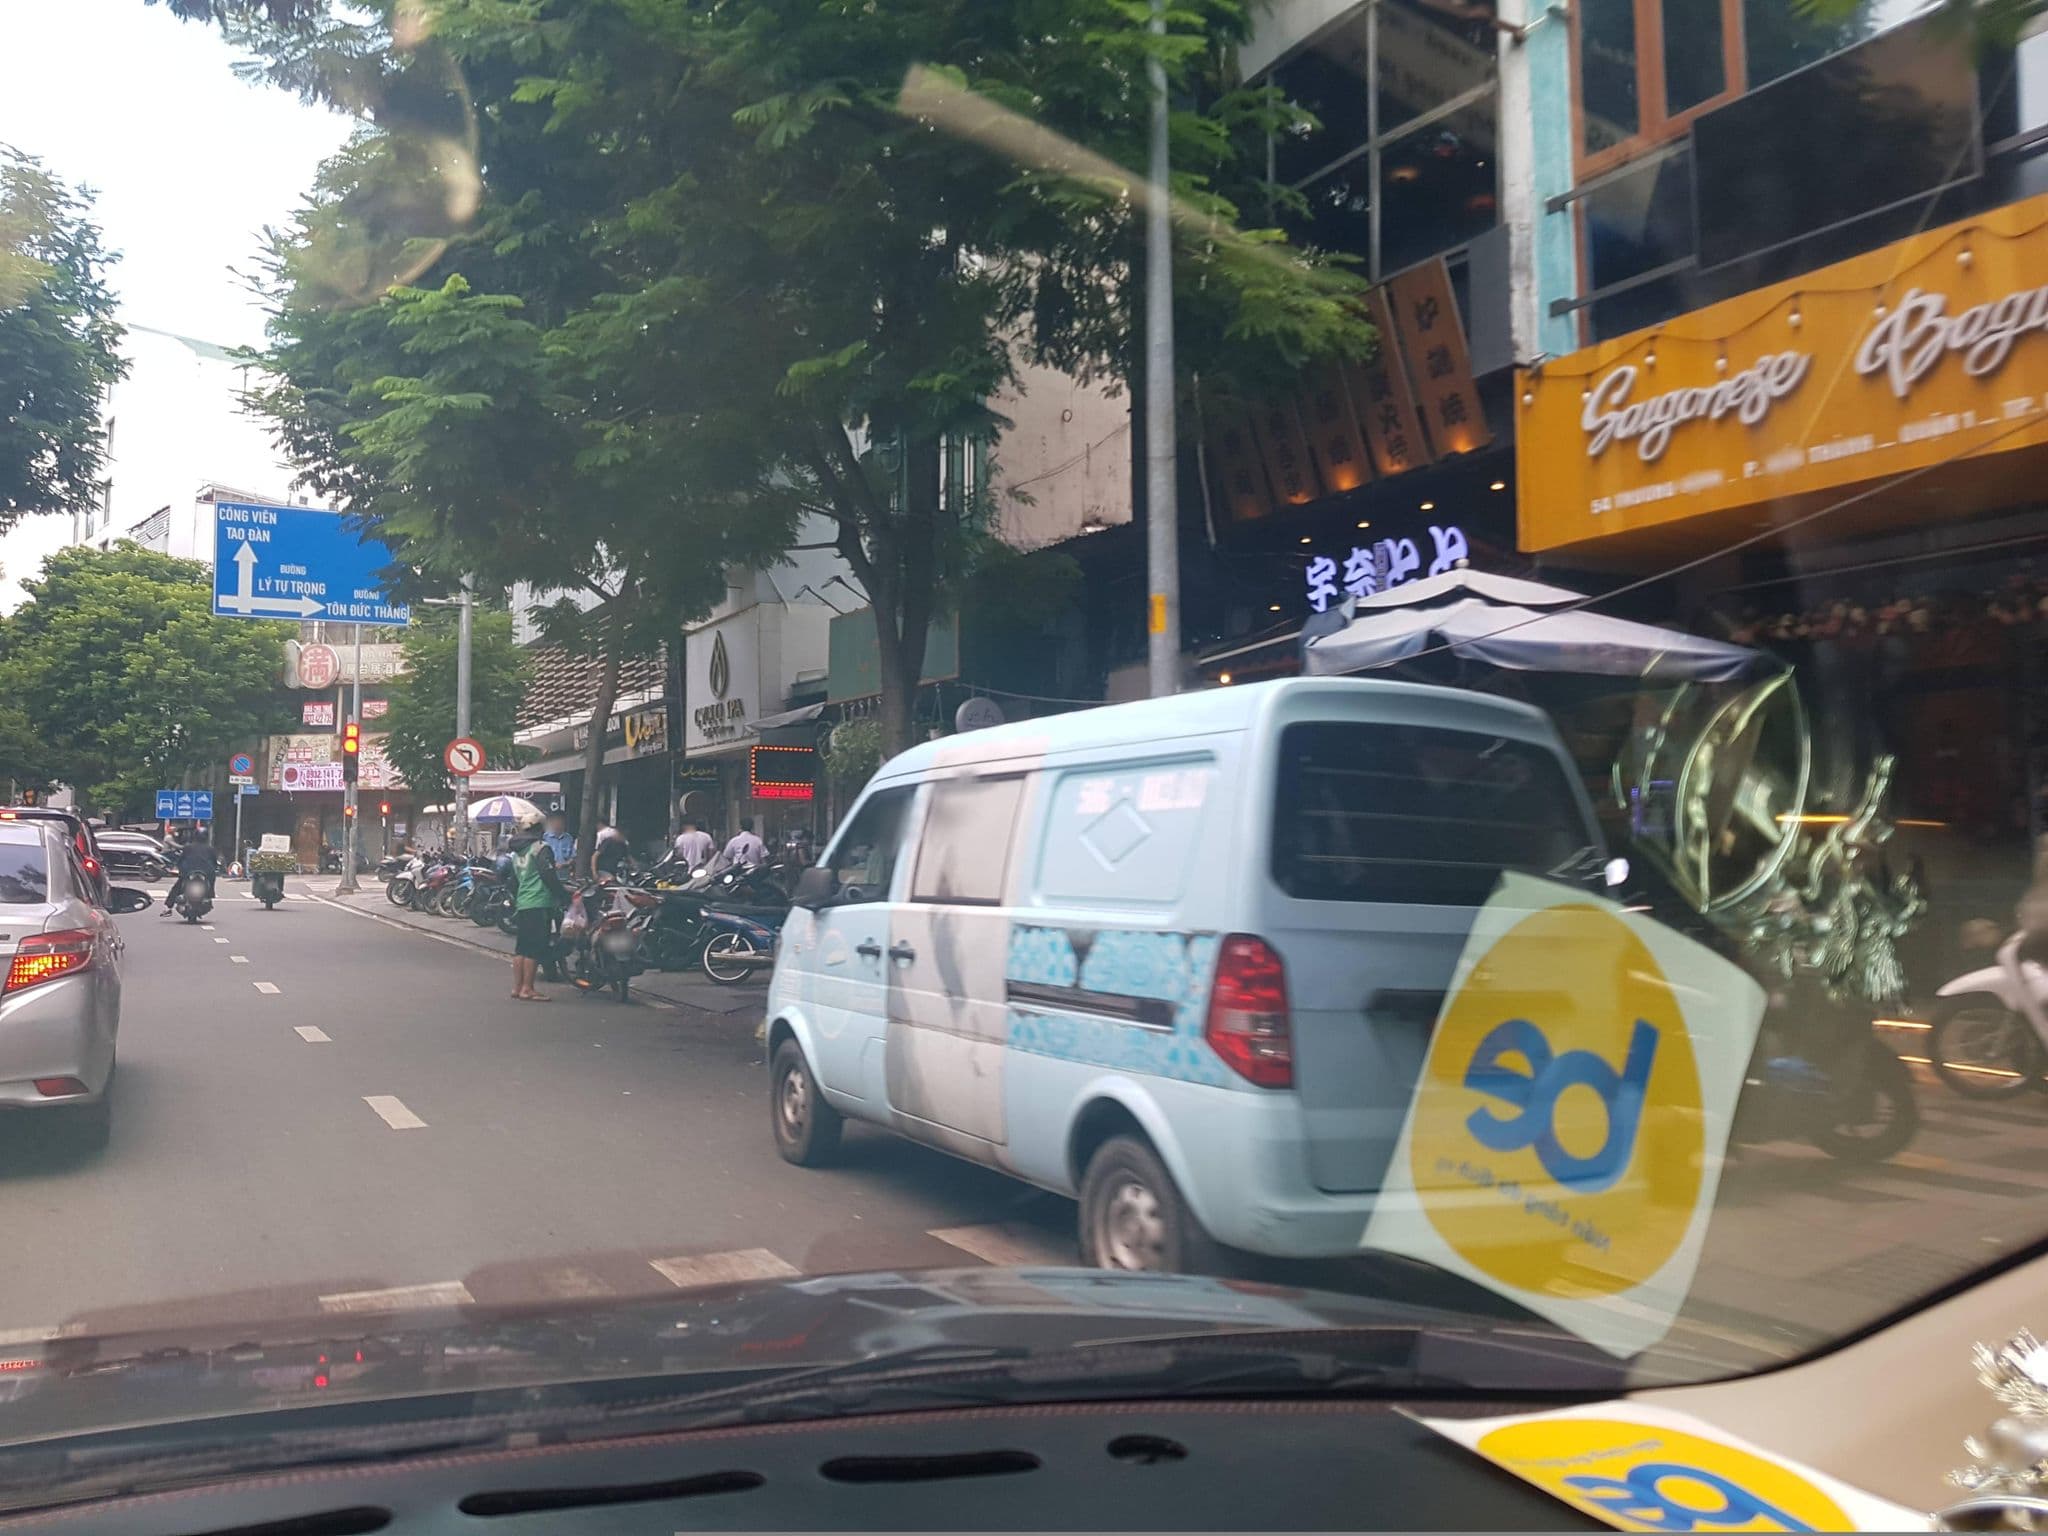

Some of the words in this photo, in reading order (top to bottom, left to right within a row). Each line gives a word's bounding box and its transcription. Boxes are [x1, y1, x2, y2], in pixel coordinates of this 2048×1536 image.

[219, 505, 249, 522] CÔNG
[251, 510, 277, 525] VIÊN
[226, 526, 245, 540] TAO
[248, 526, 270, 542] ĐÀN
[258, 576, 272, 592] LÝ
[290, 580, 326, 597] TRỌNG
[326, 601, 347, 616] TÔN
